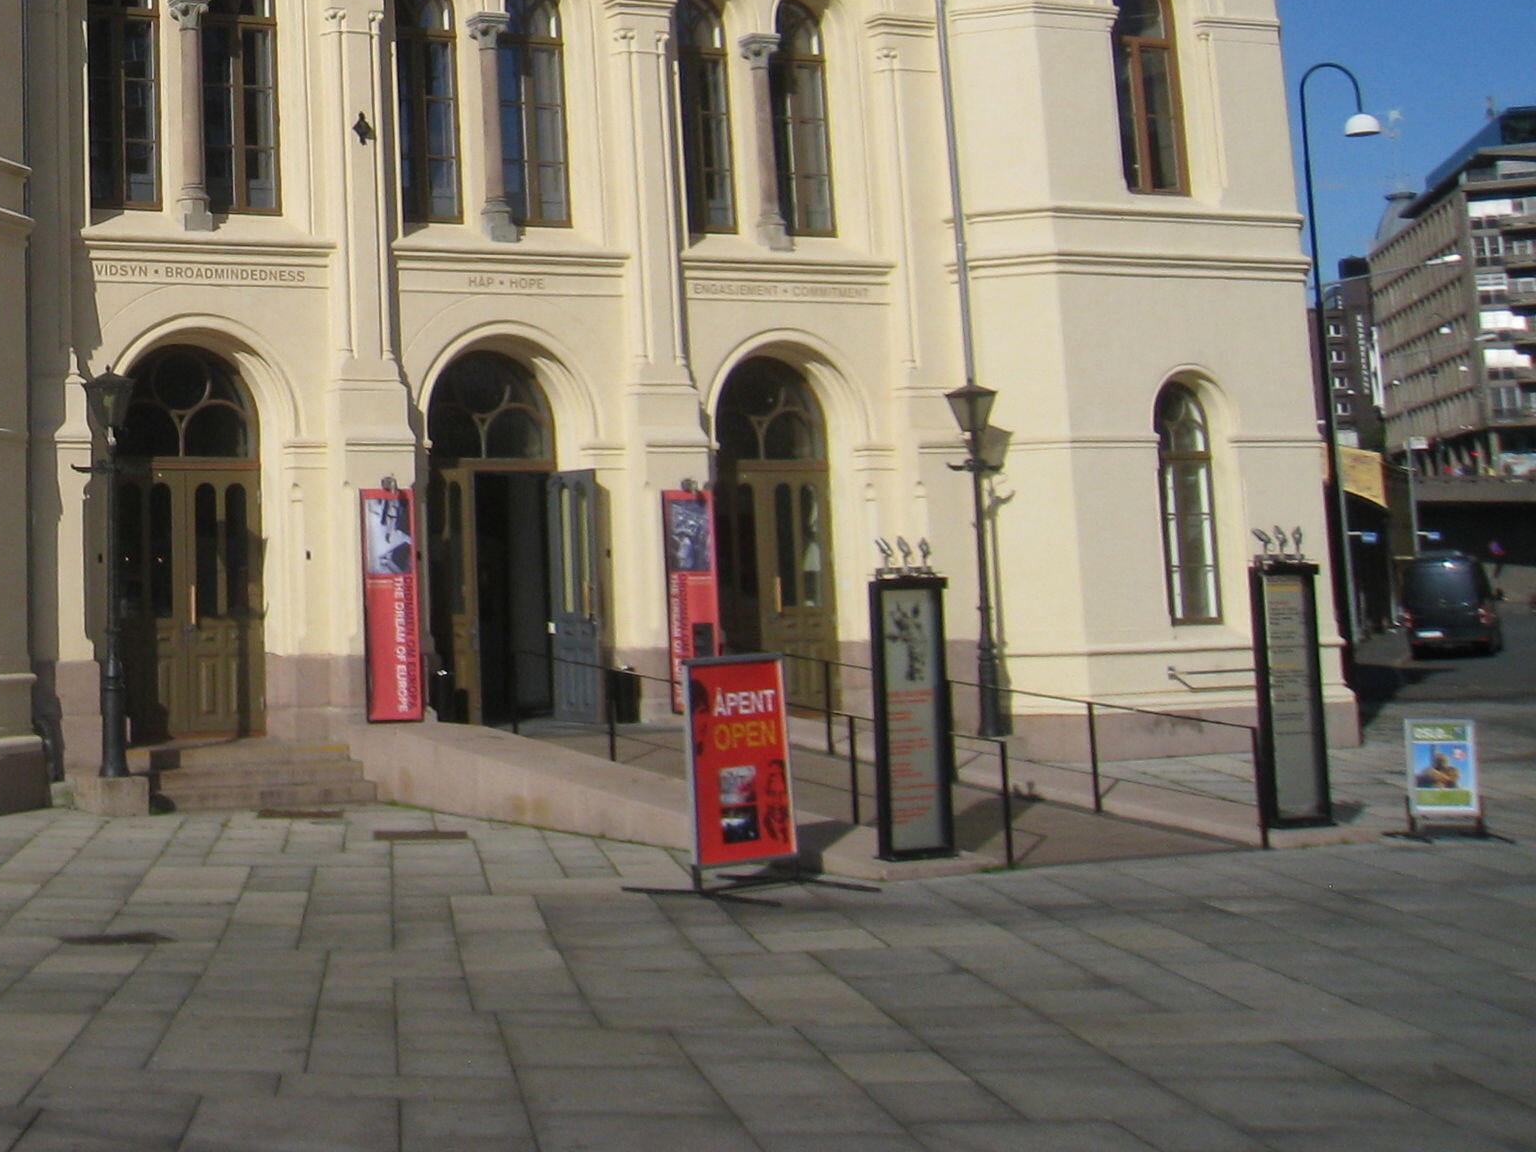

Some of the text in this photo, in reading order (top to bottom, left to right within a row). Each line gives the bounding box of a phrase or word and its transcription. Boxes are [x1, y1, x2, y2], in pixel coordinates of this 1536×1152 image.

[95, 263, 306, 282] VIDSYN BROADMINDEDNESS
[509, 278, 545, 290] HOPE
[792, 286, 869, 298] COMMITMENT
[393, 576, 408, 713] THE DREAM OF EUROPE
[713, 687, 775, 717] ÅPENT
[714, 720, 777, 751] OPEN
